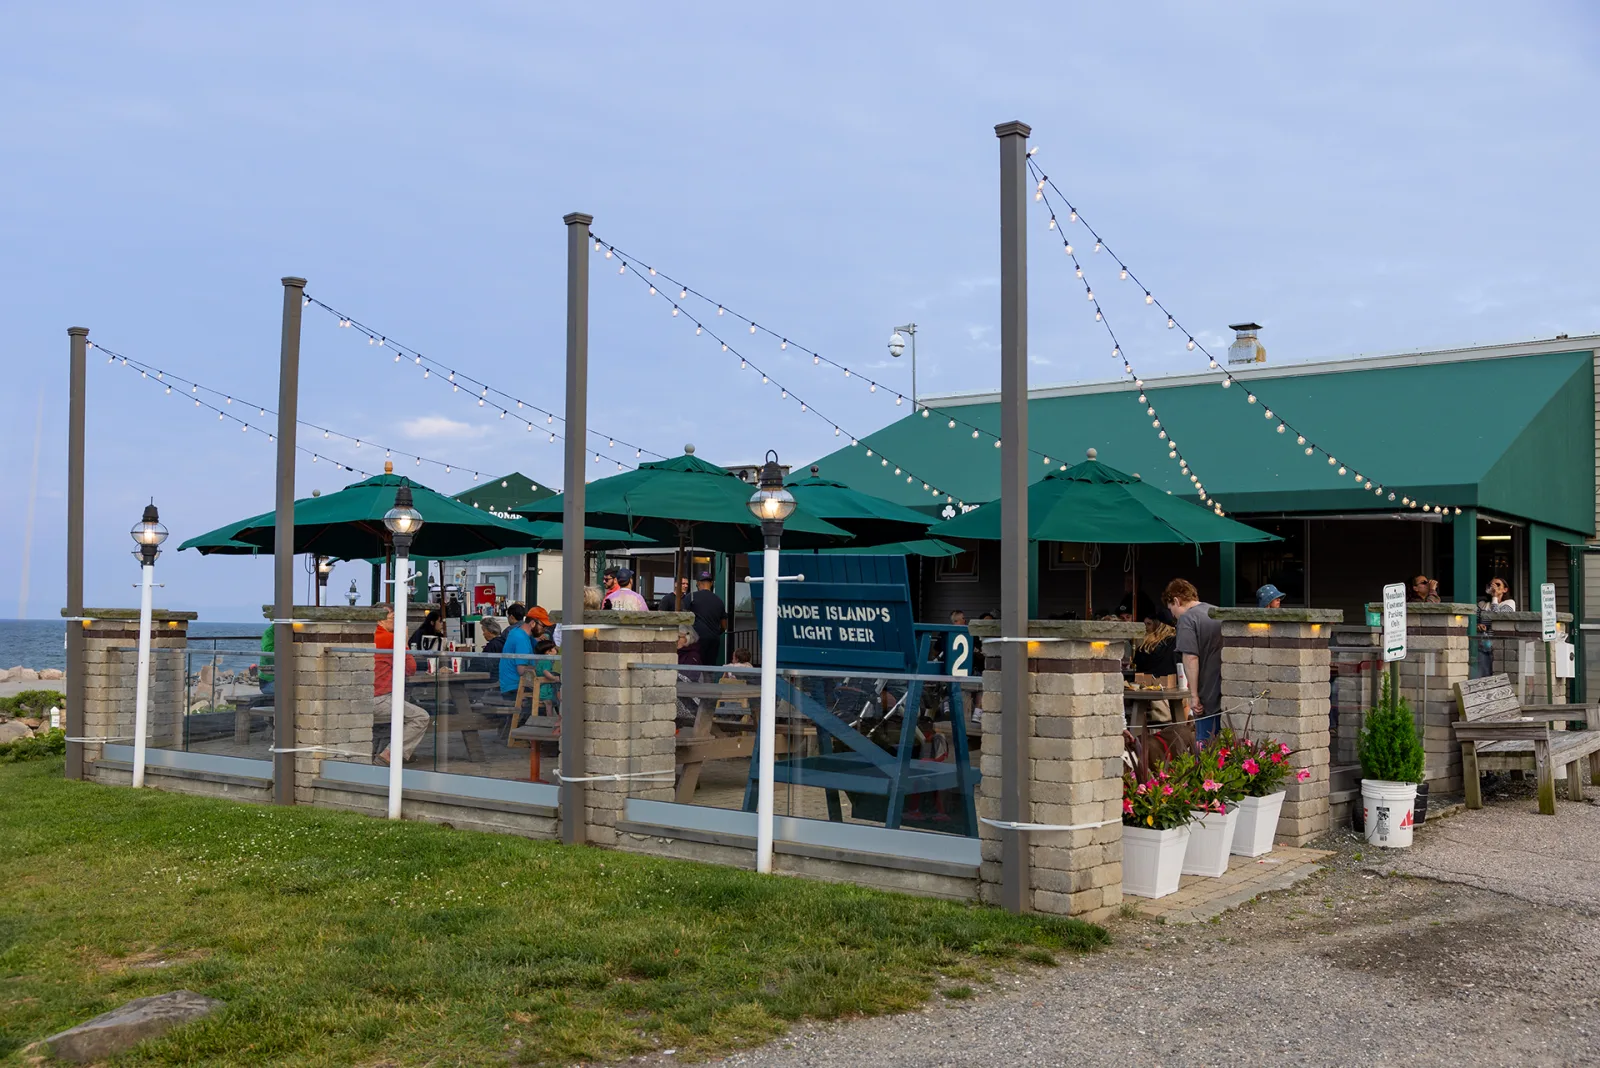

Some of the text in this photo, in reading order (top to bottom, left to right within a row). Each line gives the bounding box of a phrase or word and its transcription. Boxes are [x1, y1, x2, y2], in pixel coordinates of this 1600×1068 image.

[825, 605, 891, 623] ISLAND'S
[792, 625, 876, 643] LIGHT BEER
[951, 634, 969, 676] 2
